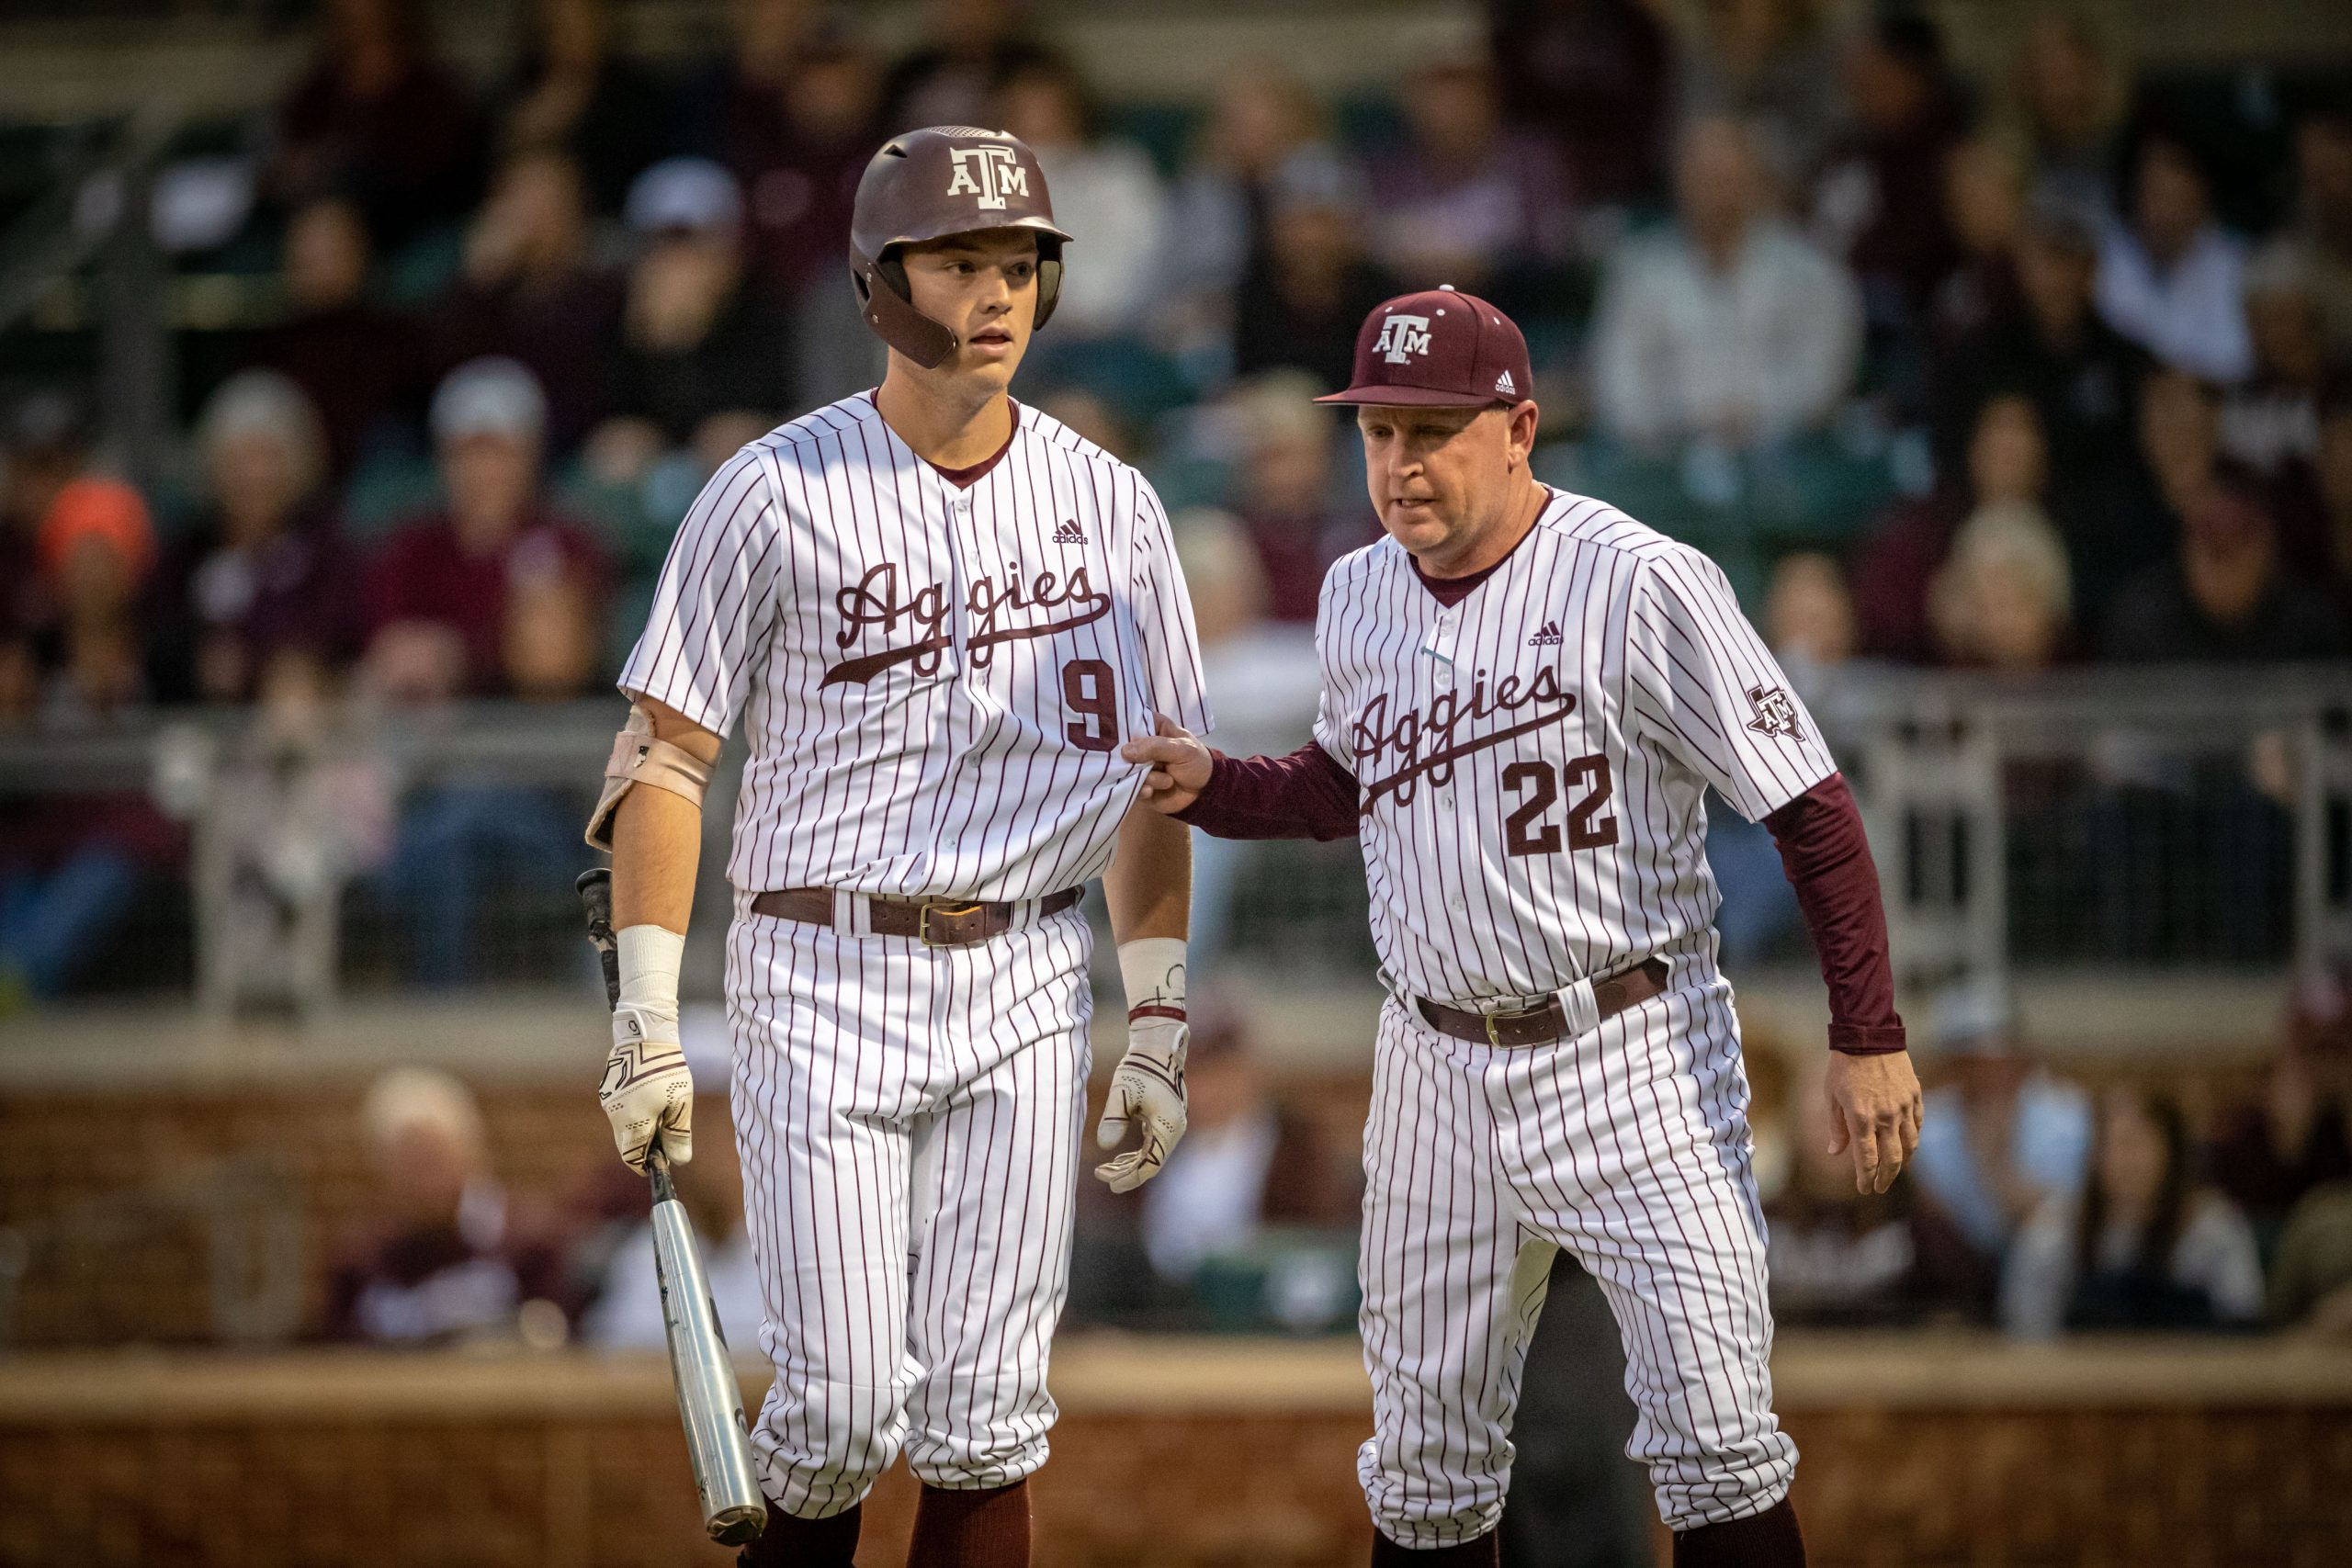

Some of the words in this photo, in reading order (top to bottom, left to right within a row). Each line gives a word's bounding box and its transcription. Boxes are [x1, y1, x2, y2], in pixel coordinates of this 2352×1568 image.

[1495, 383, 1516, 395] adidas
[1052, 534, 1088, 545] adidas
[834, 561, 1111, 678] Aggies
[1528, 634, 1564, 646] adidas
[1062, 660, 1119, 752] 9
[1352, 665, 1572, 808] Aggies
[1501, 753, 1619, 857] 22
